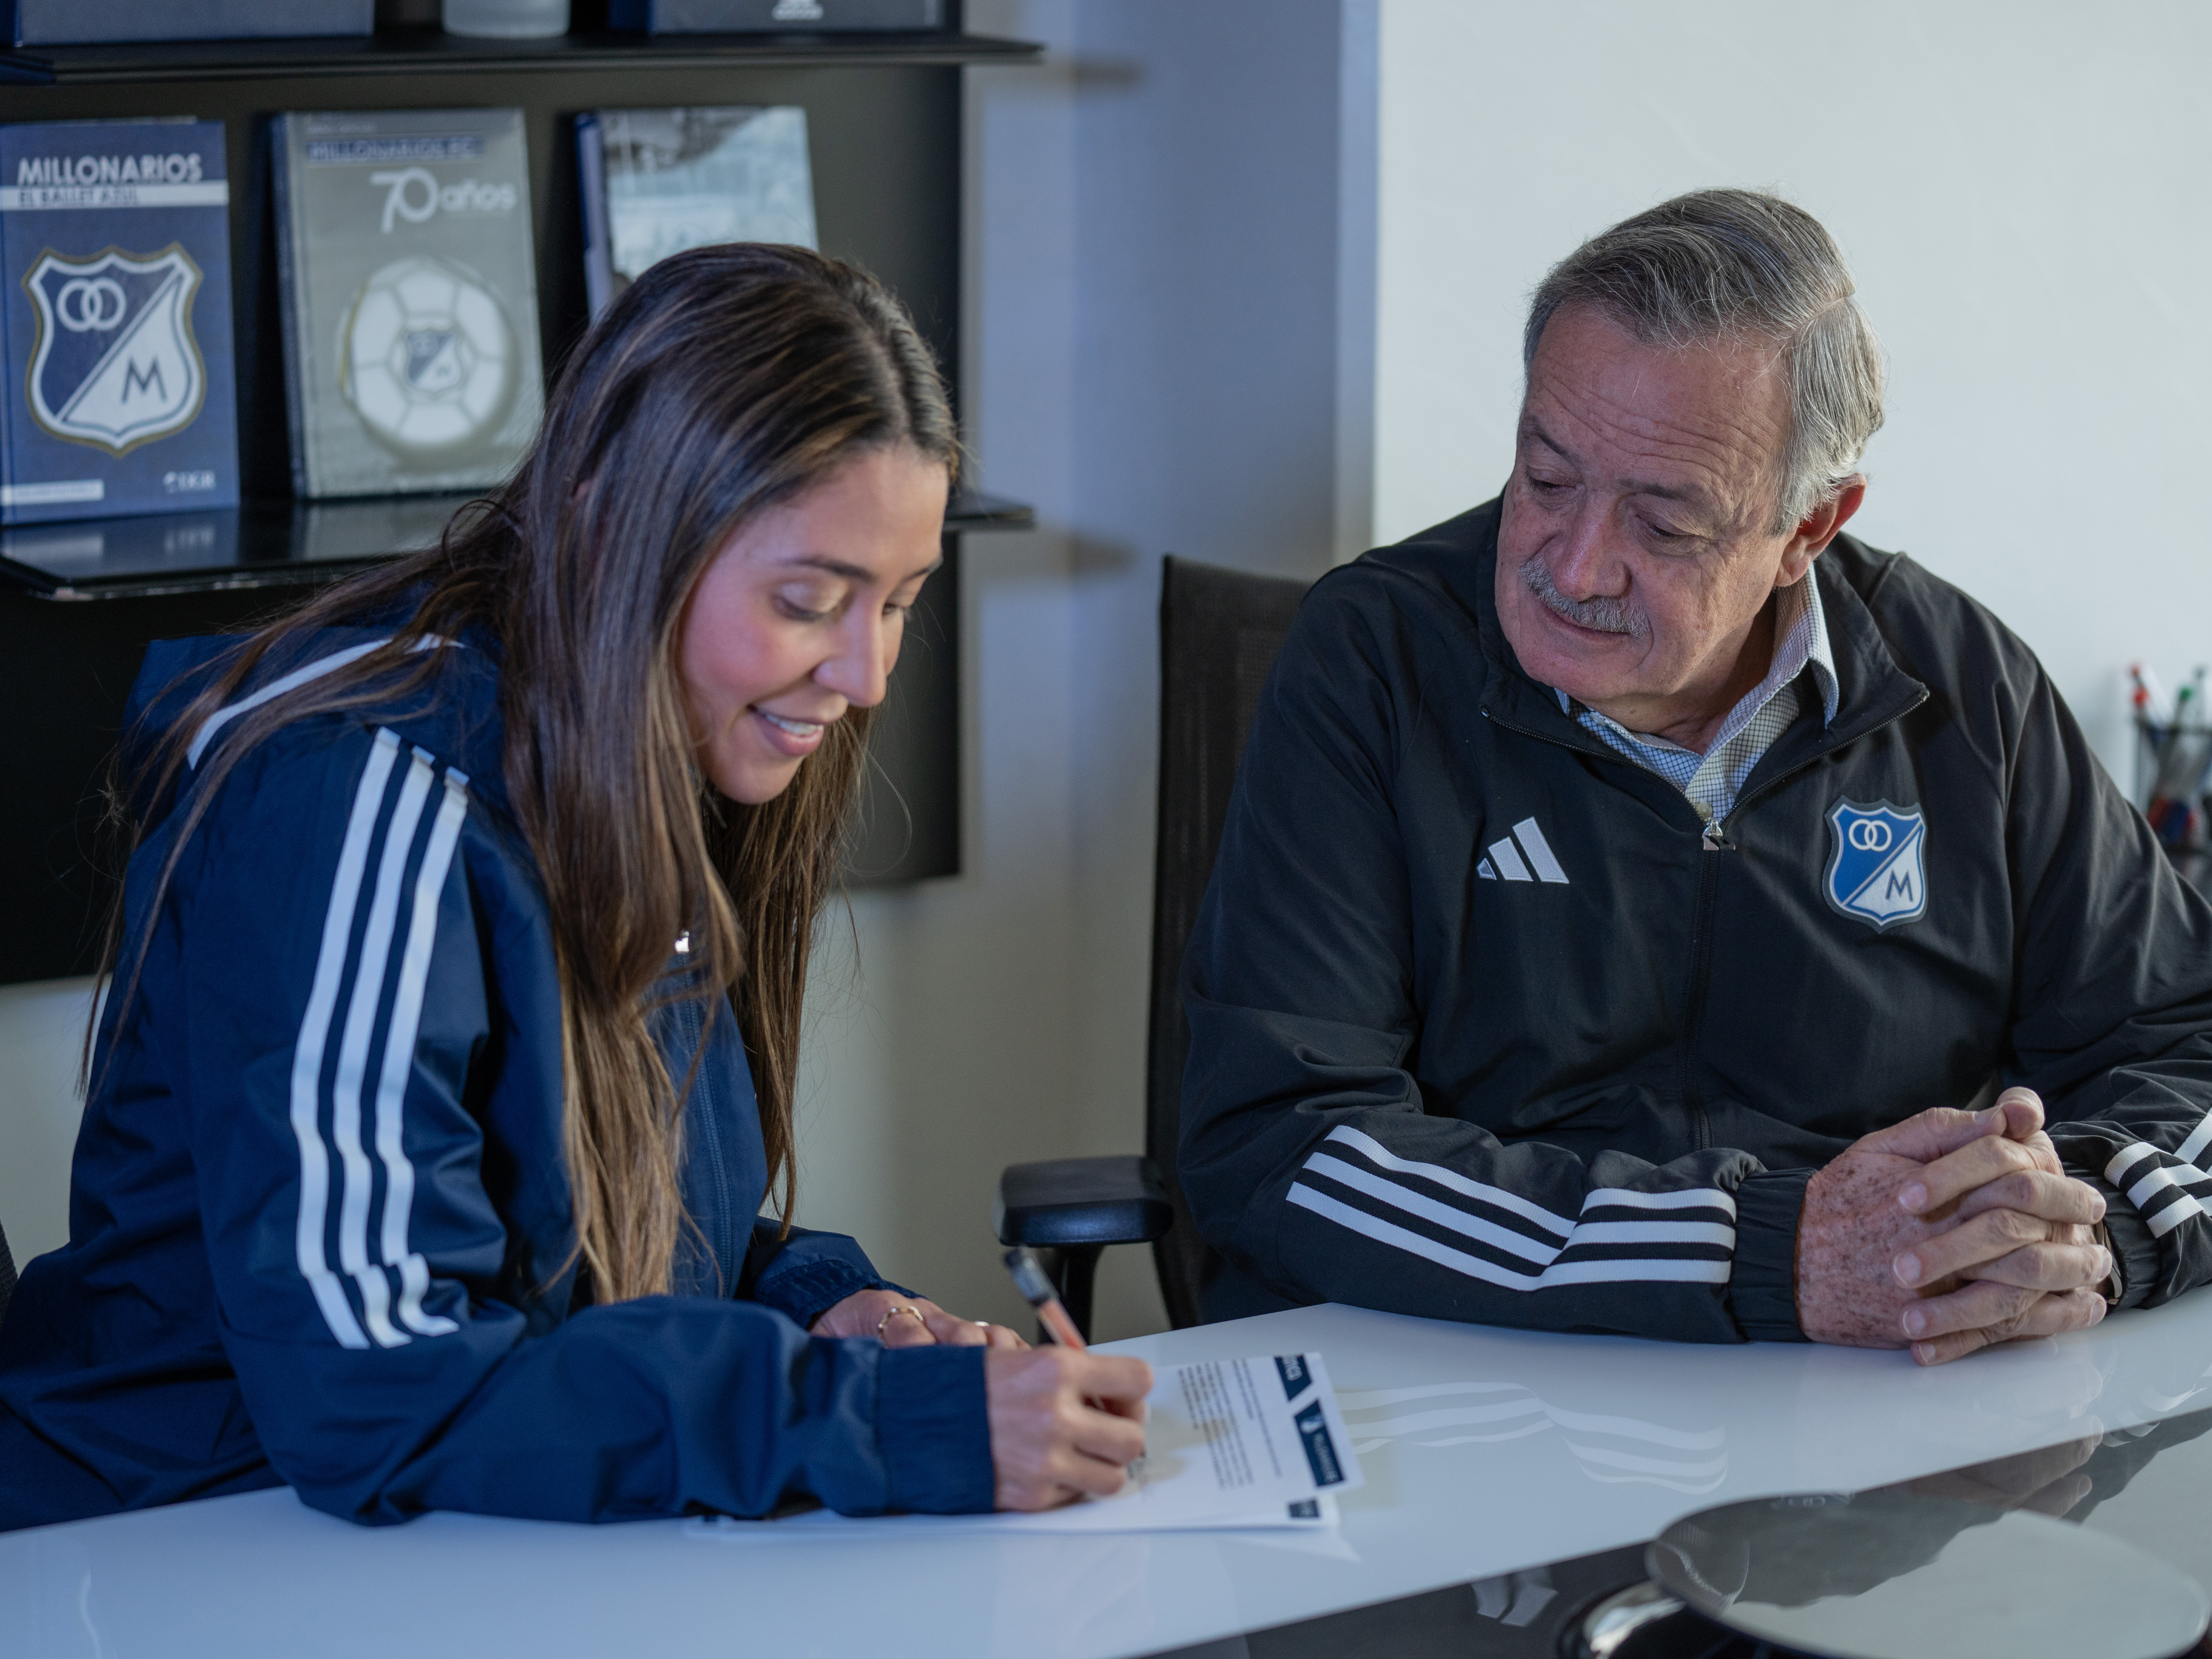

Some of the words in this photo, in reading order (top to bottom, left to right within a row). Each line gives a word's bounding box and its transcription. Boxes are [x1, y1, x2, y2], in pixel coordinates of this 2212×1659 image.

[18, 154, 202, 185] MILLONARIOS
[19, 189, 34, 207] EL
[371, 168, 439, 233] 70
[122, 356, 167, 403] M
[1886, 869, 1913, 902] M
